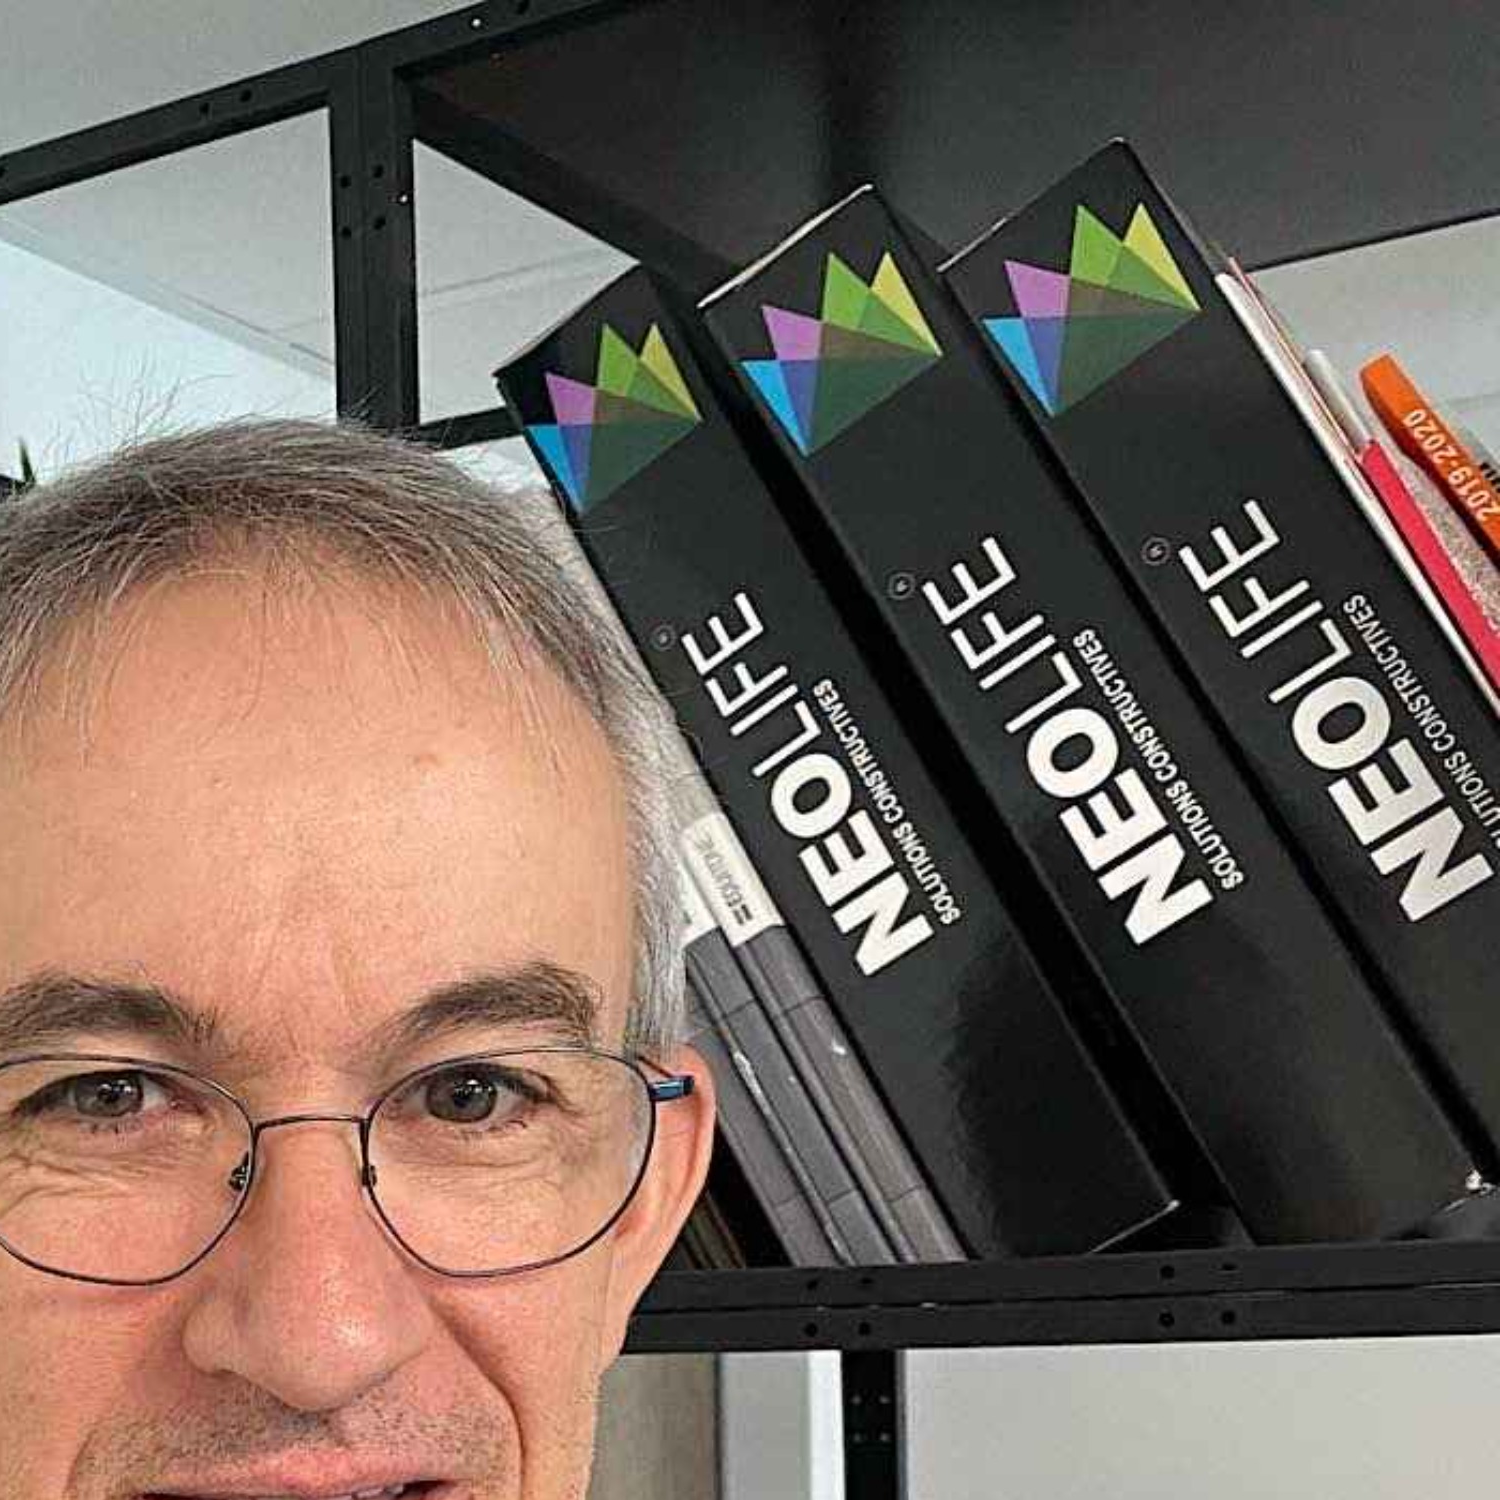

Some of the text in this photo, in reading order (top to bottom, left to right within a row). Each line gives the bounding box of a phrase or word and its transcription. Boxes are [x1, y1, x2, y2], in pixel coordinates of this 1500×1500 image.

[681, 592, 935, 977] NEOLIFE
[812, 678, 961, 926] SOLUTIONS CONSTRUCTIVES
[922, 536, 1214, 946] NEOLIFE
[1072, 628, 1244, 889] SOLUTIONS CONSTRUCTIVES
[1180, 500, 1494, 922] NEOLIFE
[1344, 594, 1500, 849] UTIONS CONSTRUCTIVES
